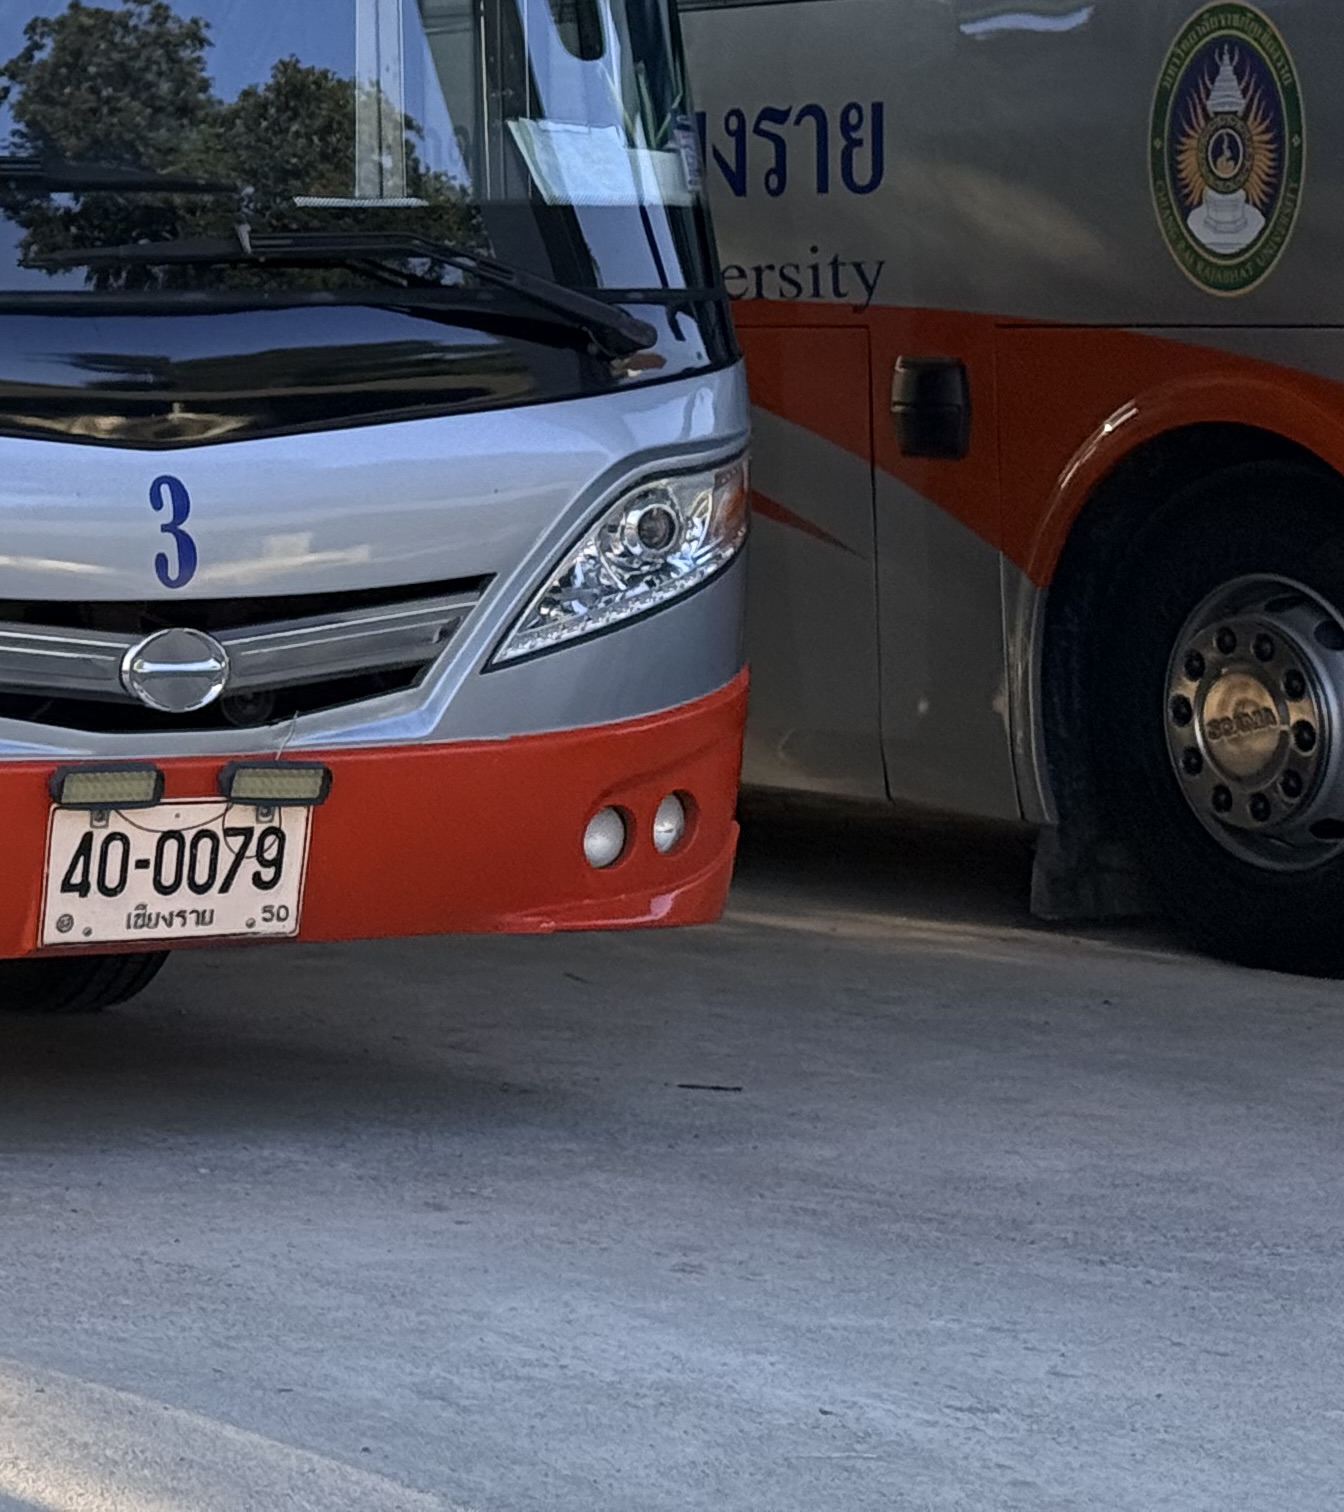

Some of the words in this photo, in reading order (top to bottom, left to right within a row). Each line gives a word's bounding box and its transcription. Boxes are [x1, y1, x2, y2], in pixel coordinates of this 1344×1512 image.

[149, 474, 198, 589] 3
[59, 826, 287, 899] 40-0079
[126, 903, 214, 930] เชียงราย
[261, 904, 289, 922] 50
